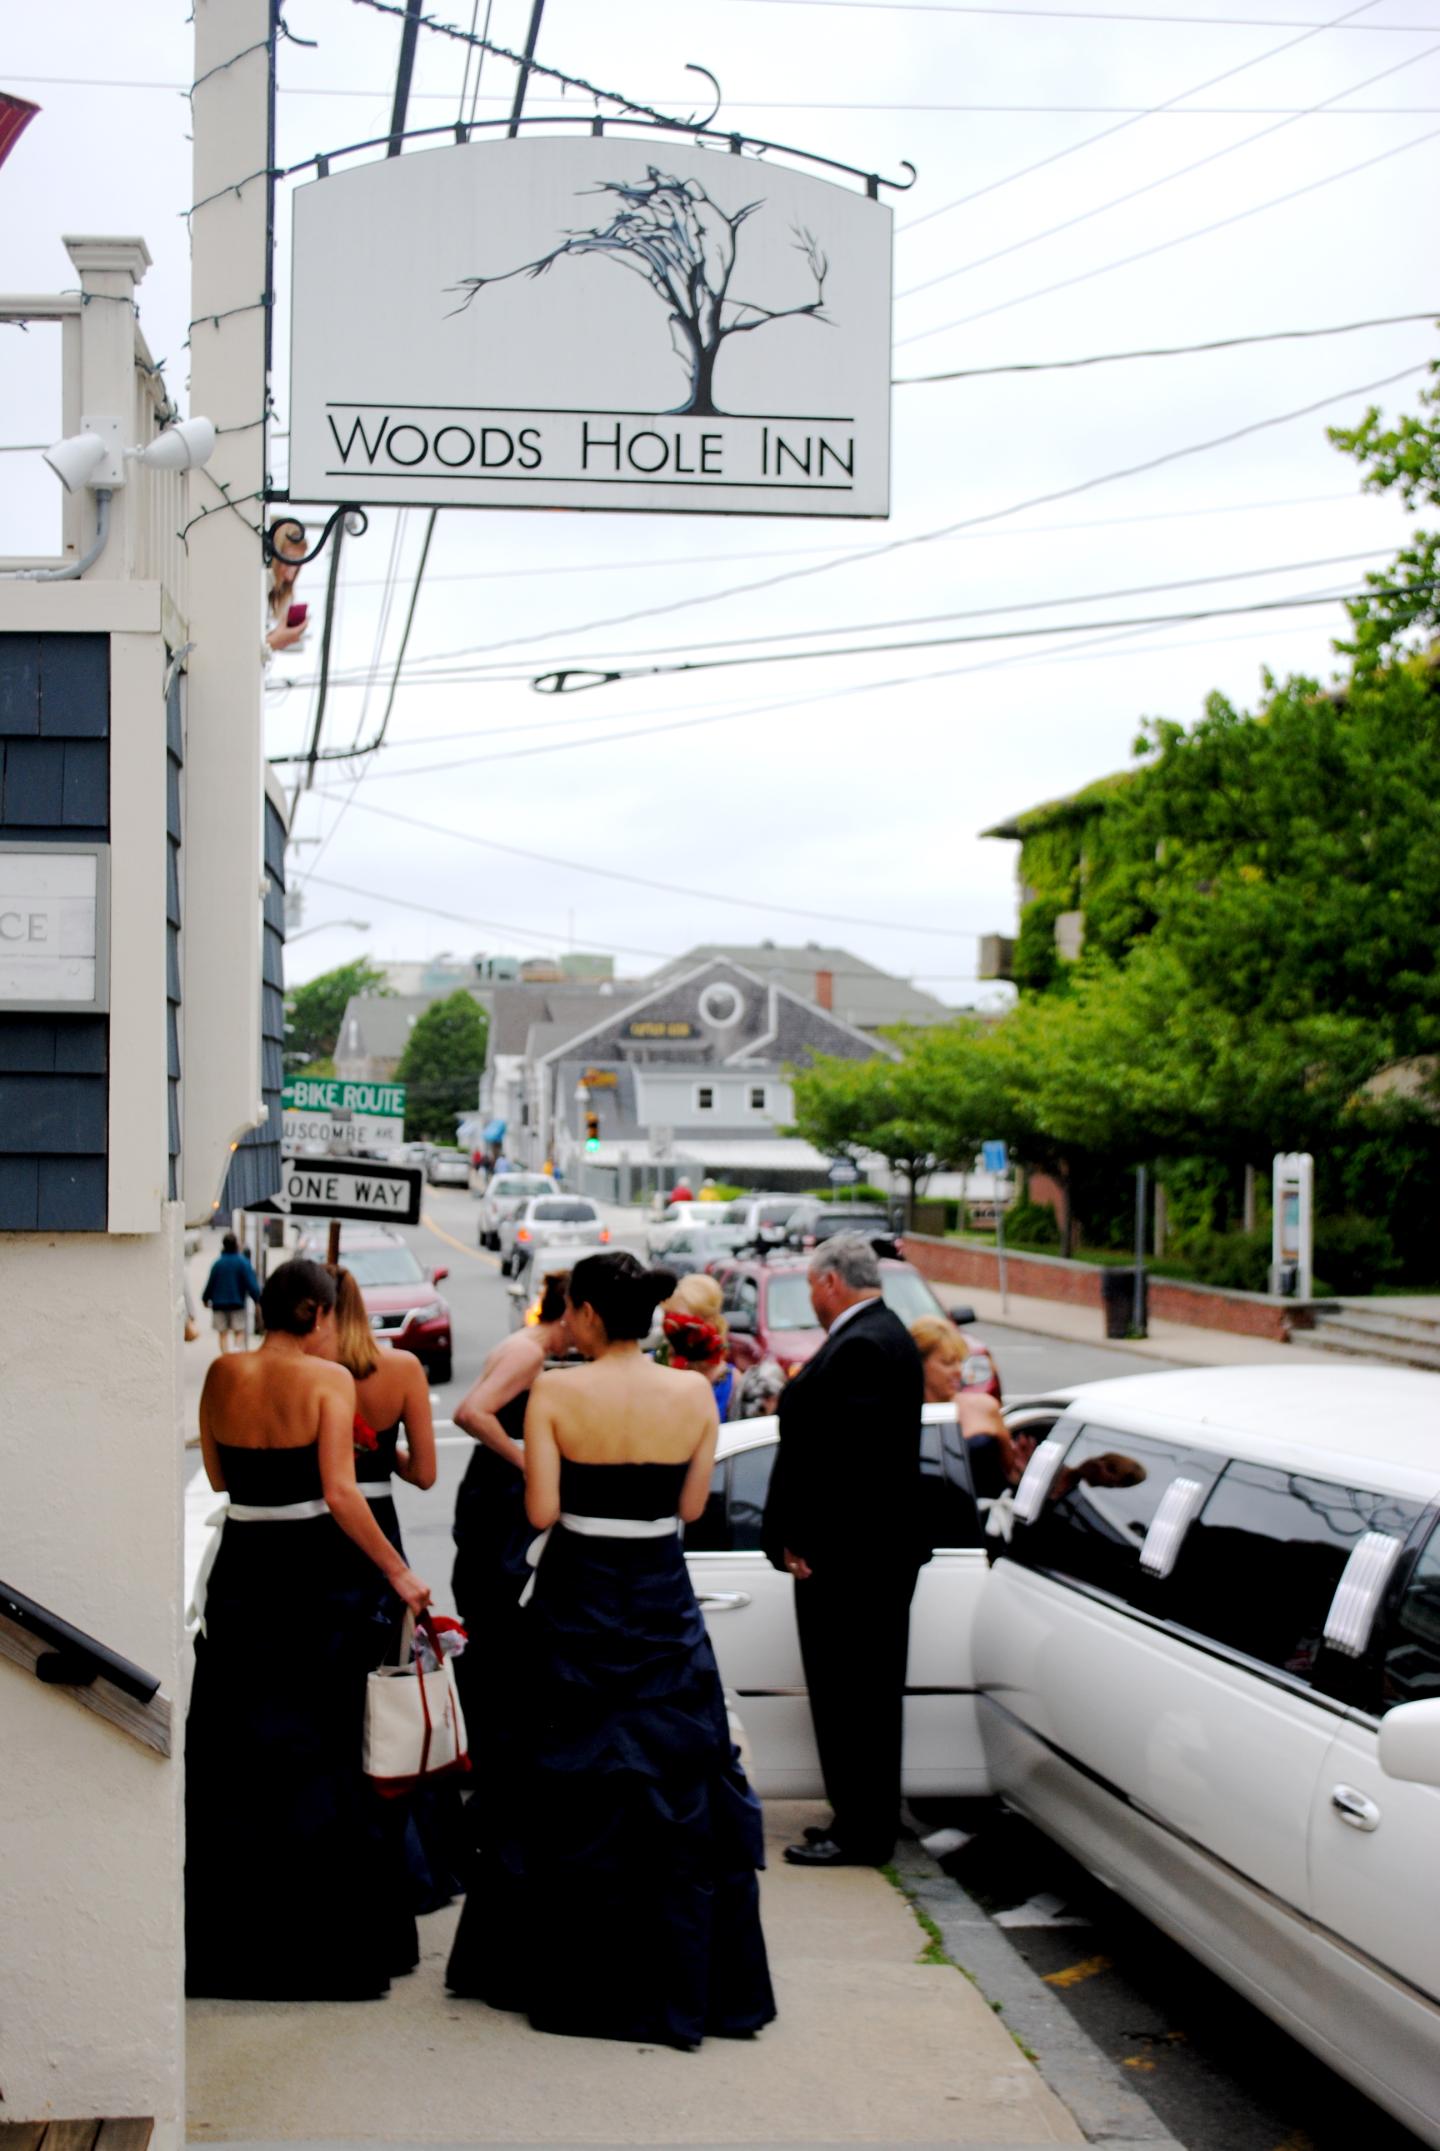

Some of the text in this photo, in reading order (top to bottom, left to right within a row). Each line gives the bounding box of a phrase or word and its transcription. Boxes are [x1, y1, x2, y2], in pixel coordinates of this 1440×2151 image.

[762, 426, 855, 479] INN
[293, 1081, 406, 1115] BIKE ROUTE
[287, 1175, 405, 1206] ONE WAY
